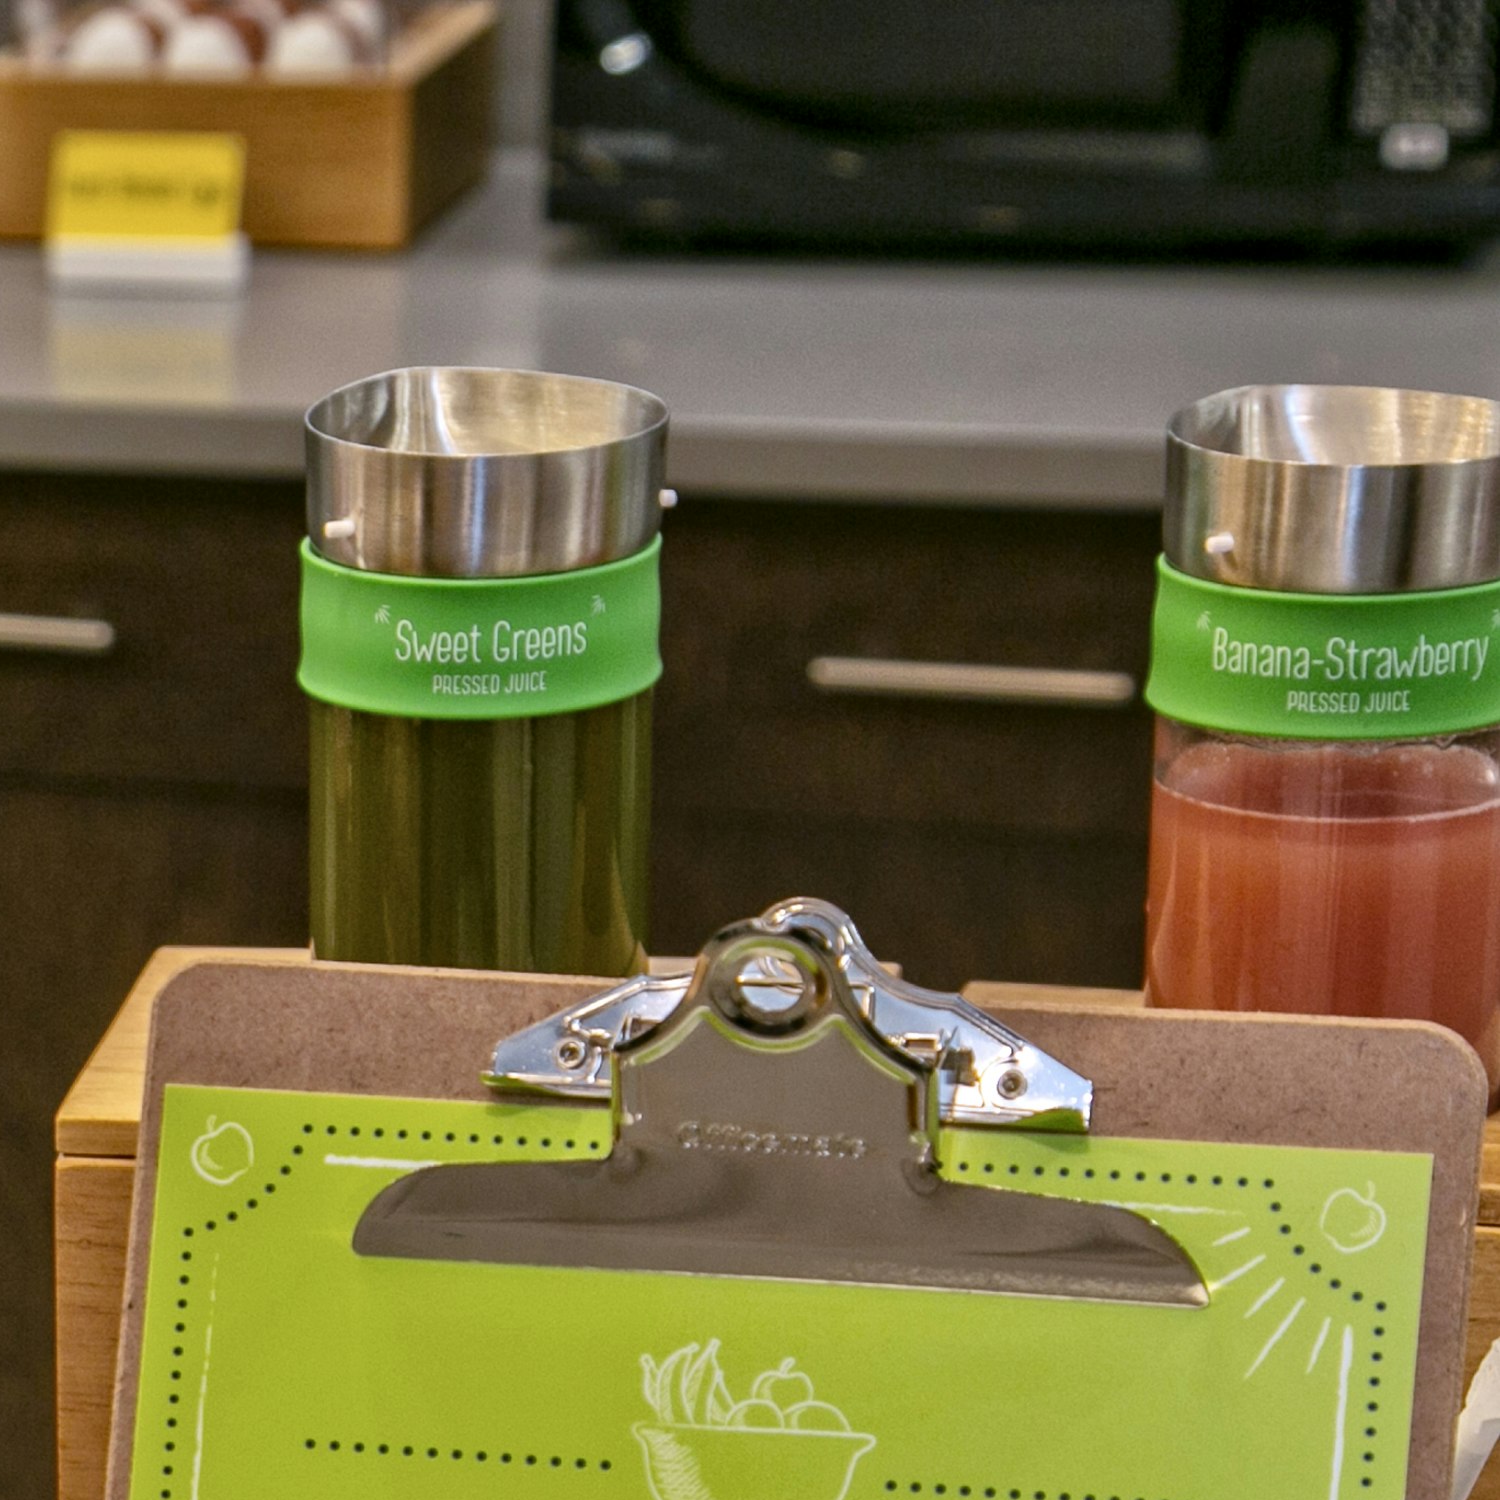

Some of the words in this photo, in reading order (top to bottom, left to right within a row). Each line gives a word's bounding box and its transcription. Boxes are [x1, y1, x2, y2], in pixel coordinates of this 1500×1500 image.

[395, 619, 482, 663] Sweet
[492, 620, 587, 663] Greens
[1212, 626, 1489, 682] Banana-Strawberry
[432, 673, 500, 695] PRESSED
[504, 670, 547, 694] JUICE
[1287, 690, 1360, 713] PRESSED
[1364, 690, 1411, 713] JUICE
